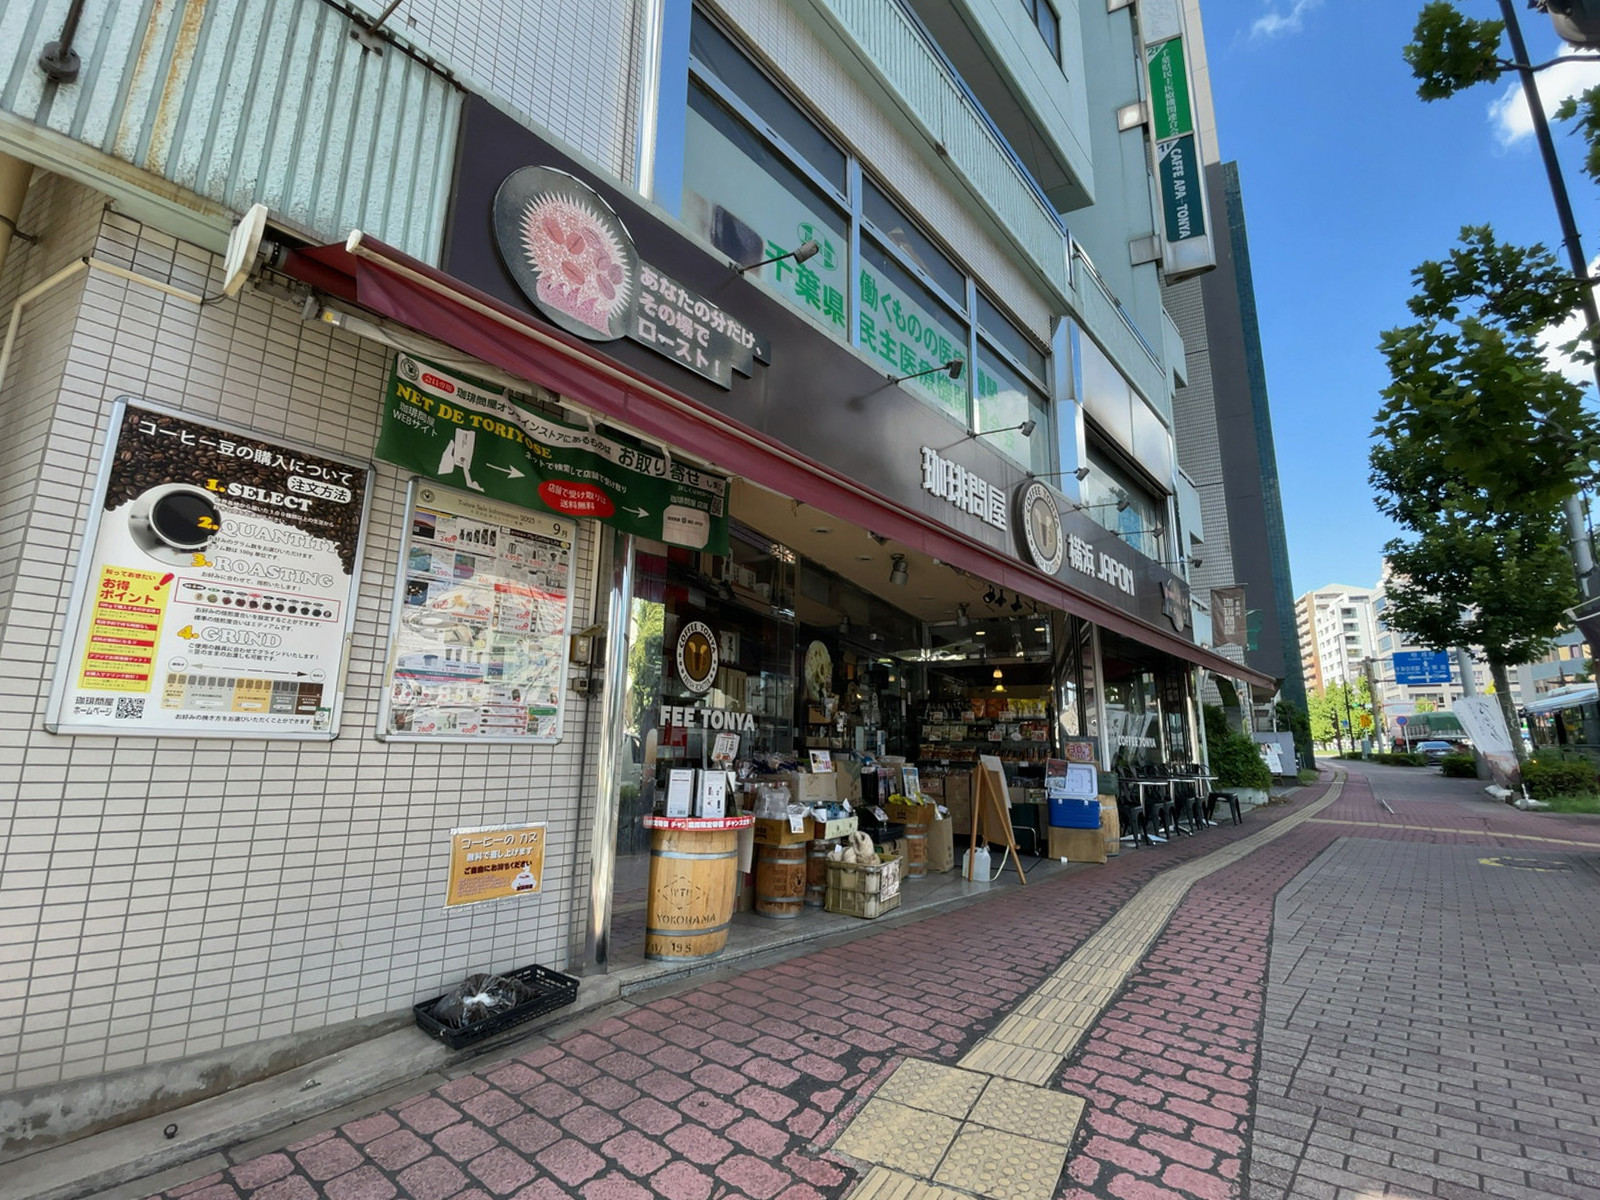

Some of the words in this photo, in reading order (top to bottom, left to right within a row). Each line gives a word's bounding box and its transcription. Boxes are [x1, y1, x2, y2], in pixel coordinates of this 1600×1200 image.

[1170, 148, 1184, 178] CAFFE
[1176, 204, 1191, 239] TONYA
[764, 239, 846, 329] 千葉県
[639, 291, 711, 348] その場で
[392, 408, 438, 437] WEBサイト
[396, 382, 434, 412] NET
[437, 403, 465, 425] DE
[469, 415, 553, 459] TORIYOSE
[399, 401, 436, 427] 珈琲問屋
[138, 419, 354, 487] コーヒー豆の購入について
[618, 447, 701, 487] お取り寄せ
[205, 479, 226, 493] 1.
[227, 482, 313, 512] SELECT
[290, 477, 349, 502] 注文方法
[920, 446, 1008, 531] 珈琲問屋
[197, 516, 220, 531] 2.
[220, 519, 341, 554] QUANTITY
[552, 522, 562, 535] 9
[105, 568, 157, 581] 知っておきたい
[190, 553, 214, 567] 3.
[213, 555, 335, 588] ROASTING
[1066, 532, 1096, 578] 横浜
[1097, 551, 1136, 597] JAPON
[99, 588, 156, 604] ポイント
[101, 578, 131, 591] お得
[177, 625, 200, 640] 4.
[201, 626, 282, 648] GRIND
[73, 705, 113, 717] ホームページ
[700, 709, 756, 732] TONYA
[1118, 735, 1139, 748] COFFEE
[656, 913, 716, 925] YOKOHAMA
